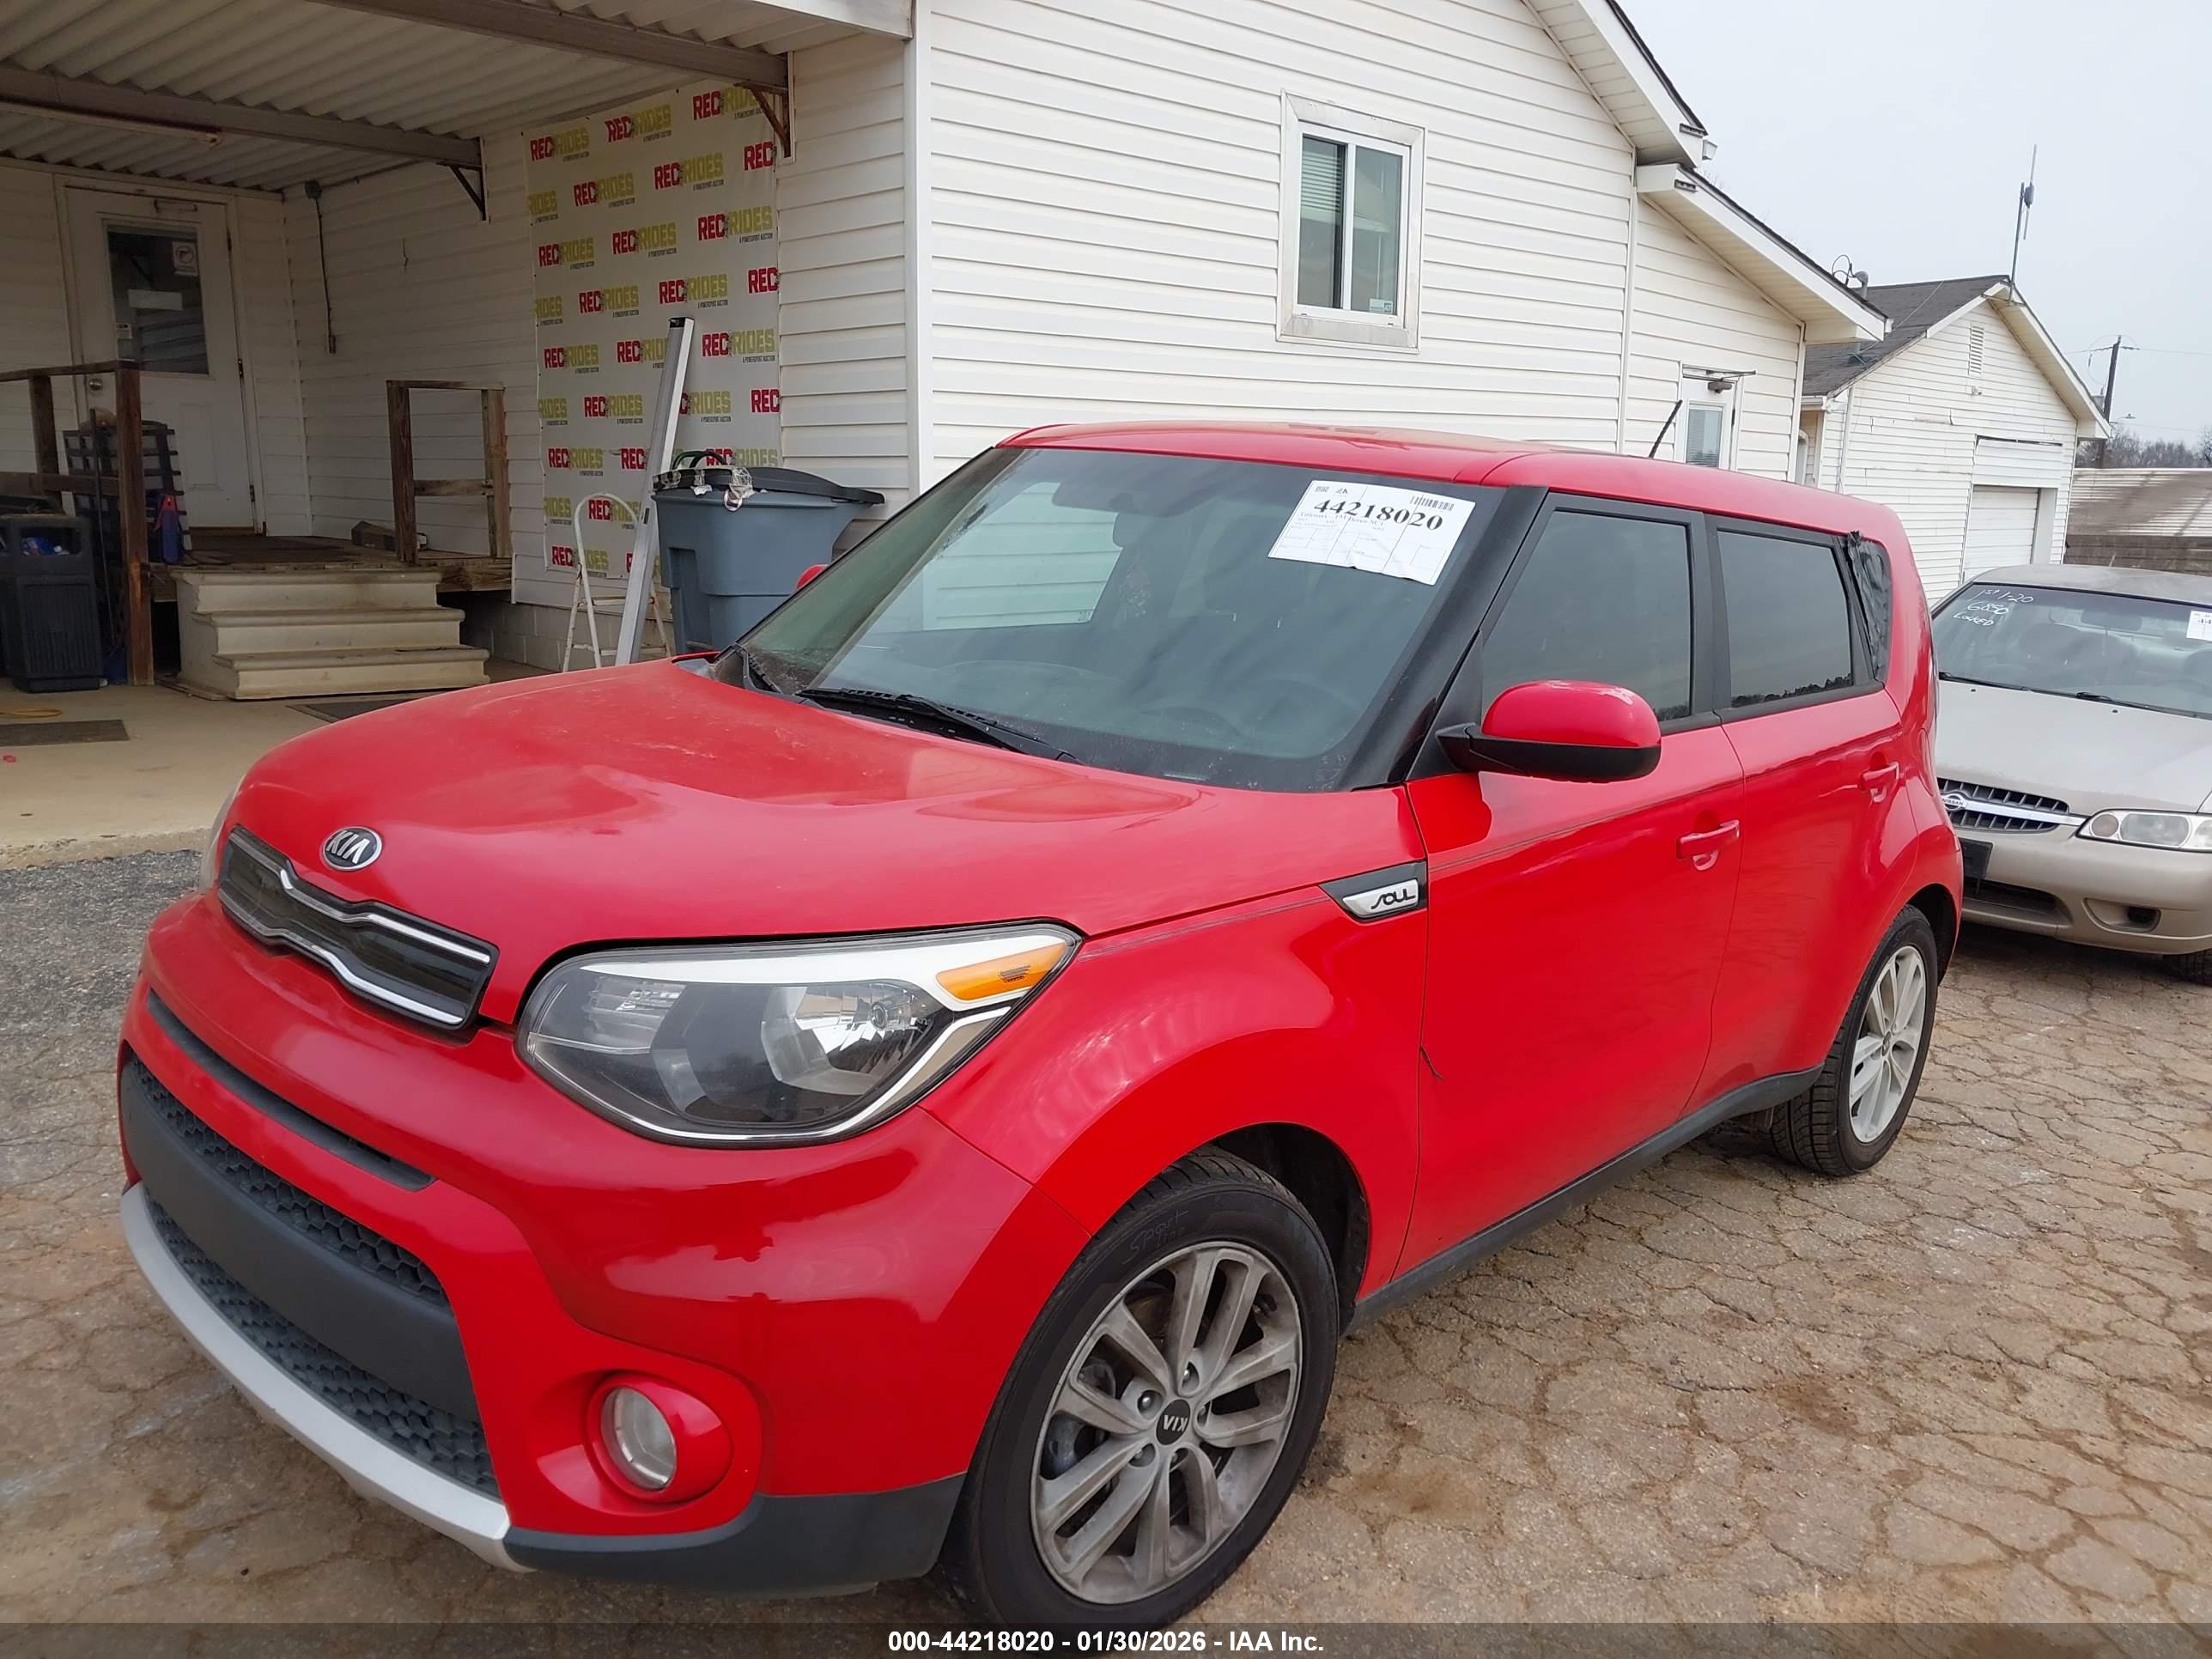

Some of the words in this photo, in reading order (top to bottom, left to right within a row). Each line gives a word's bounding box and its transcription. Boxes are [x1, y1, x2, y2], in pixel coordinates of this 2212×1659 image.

[1314, 499, 1443, 531] 44218020
[325, 830, 371, 864] KIA
[1162, 1413, 1189, 1433] KIA
